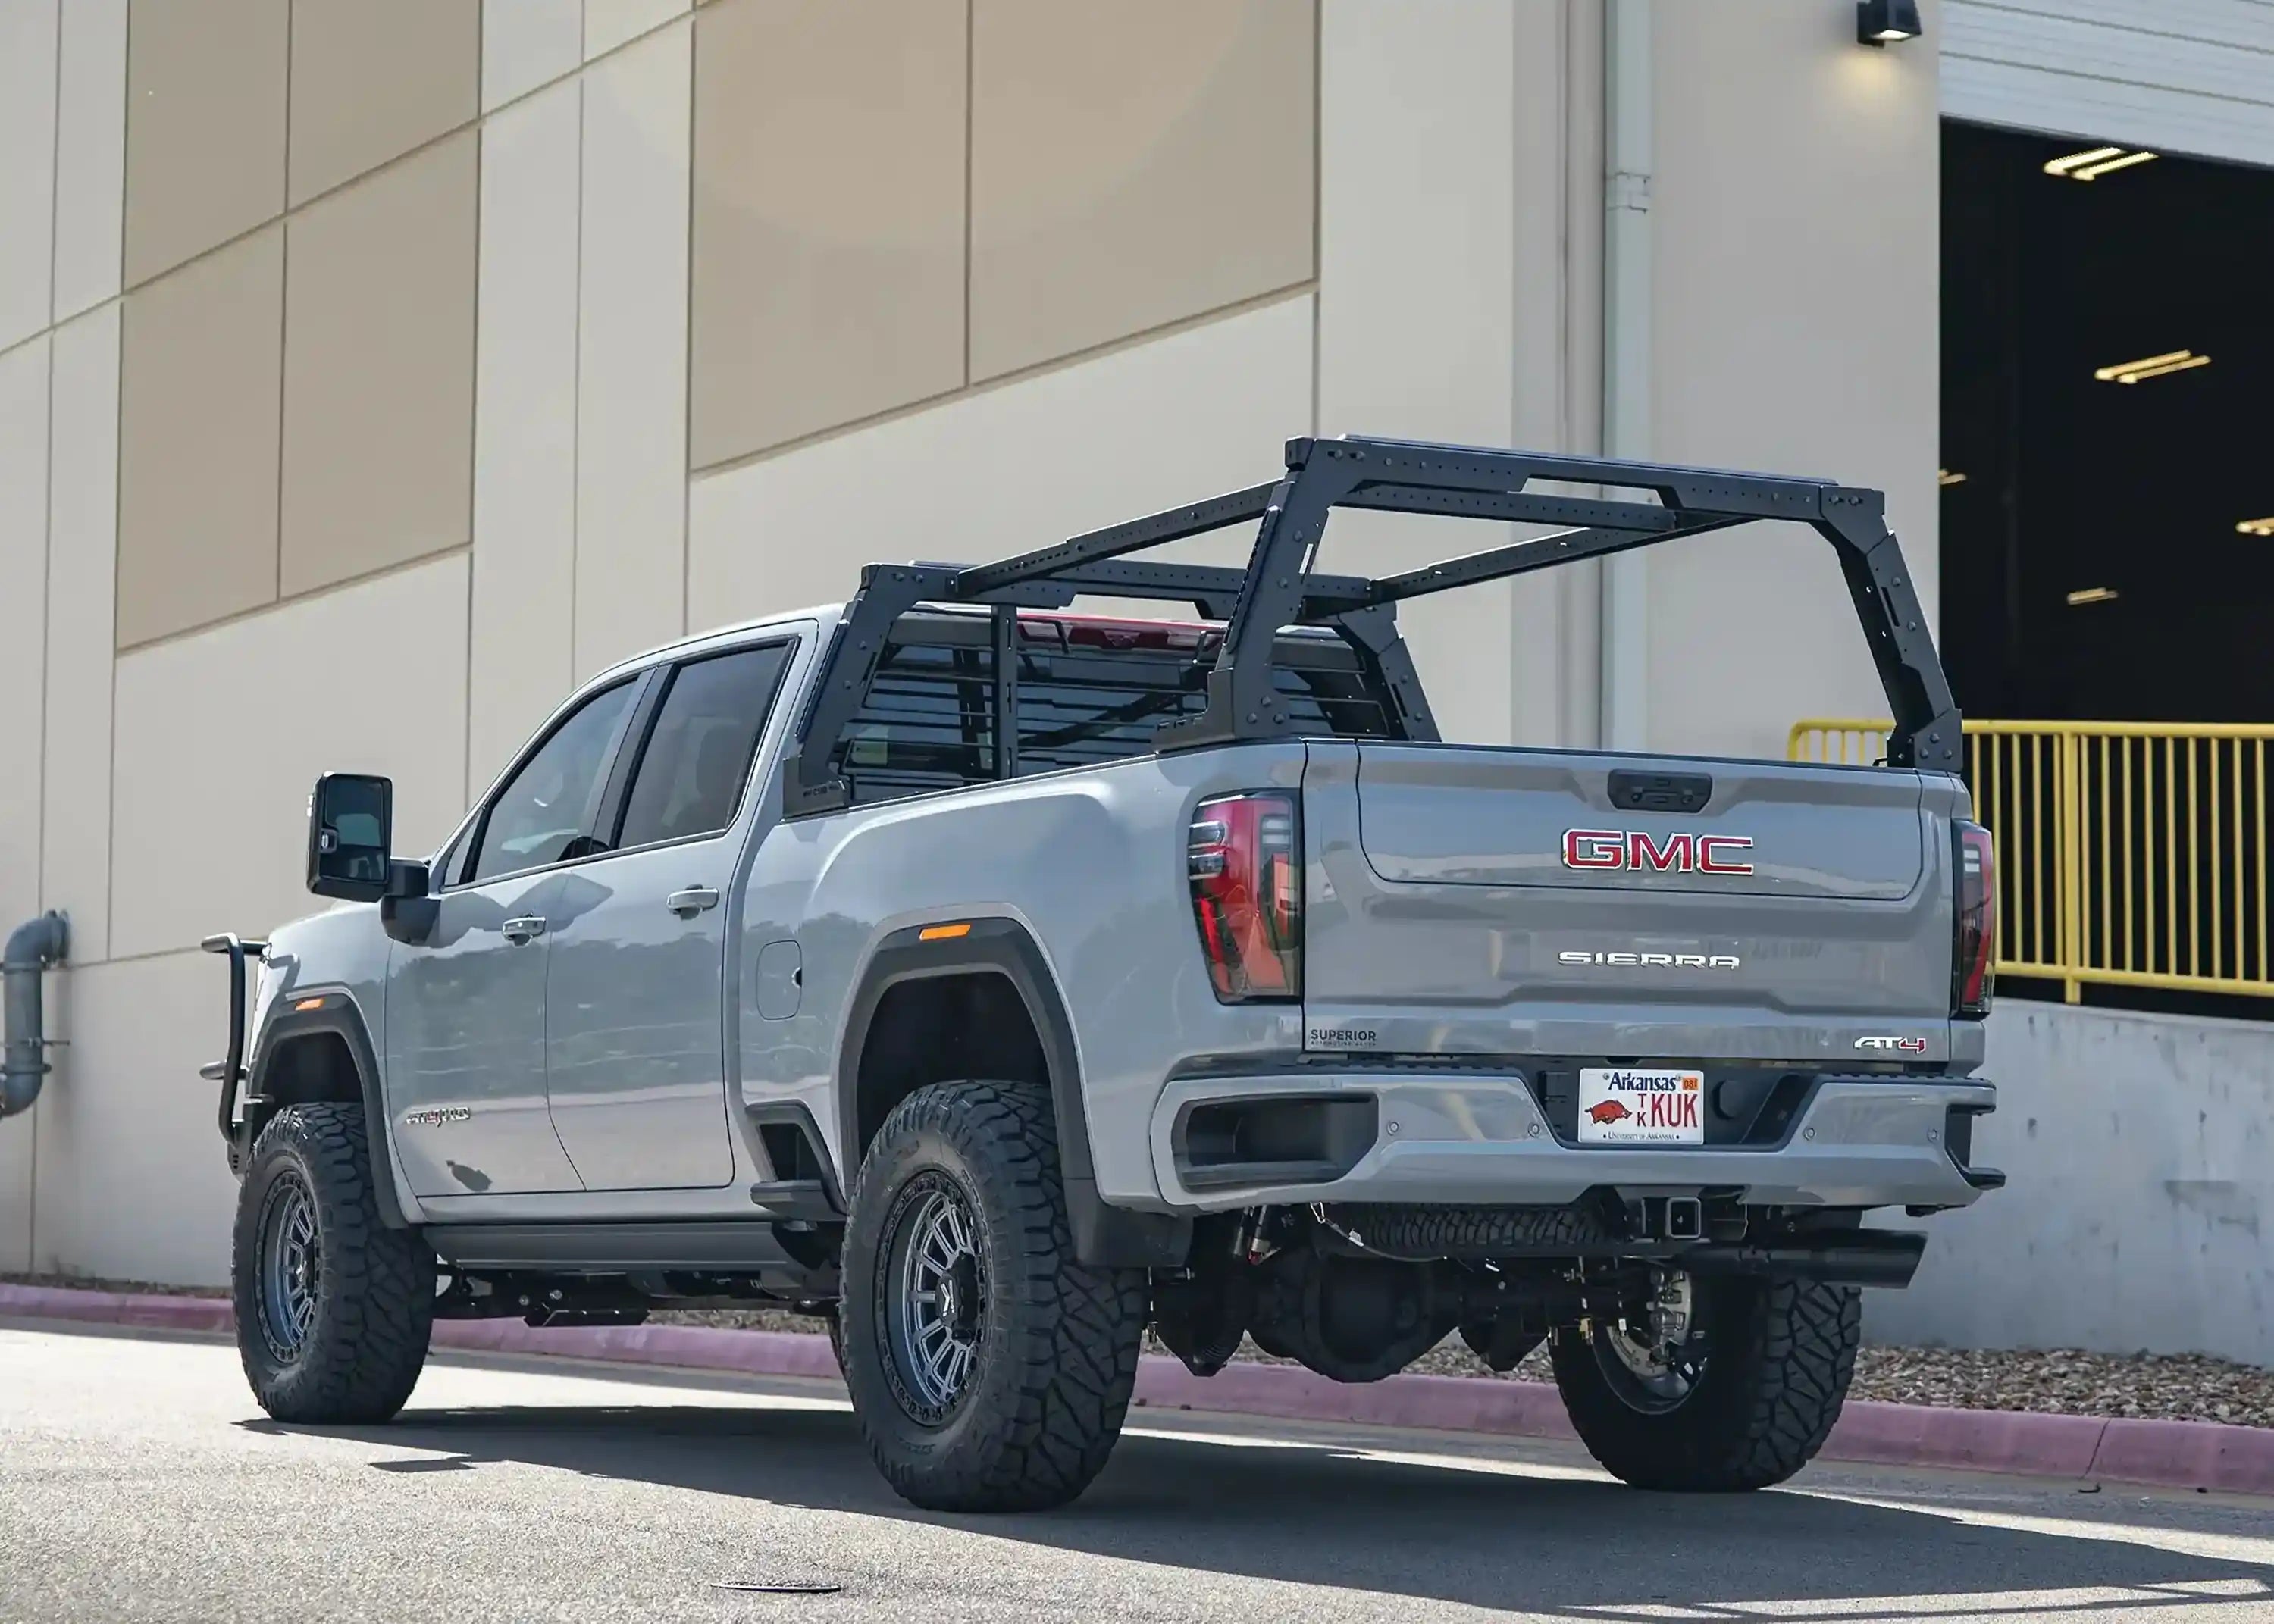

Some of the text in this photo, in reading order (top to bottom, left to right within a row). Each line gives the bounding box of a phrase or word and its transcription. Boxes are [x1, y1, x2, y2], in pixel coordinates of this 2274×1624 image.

[1563, 828, 1753, 875] GMC
[1558, 951, 1740, 970] SIERRA
[1311, 1029, 1377, 1041] SUPERIOR
[1853, 1036, 1926, 1054] AT4
[1608, 1072, 1677, 1091] Arkansas
[1651, 1093, 1698, 1128] KUK
